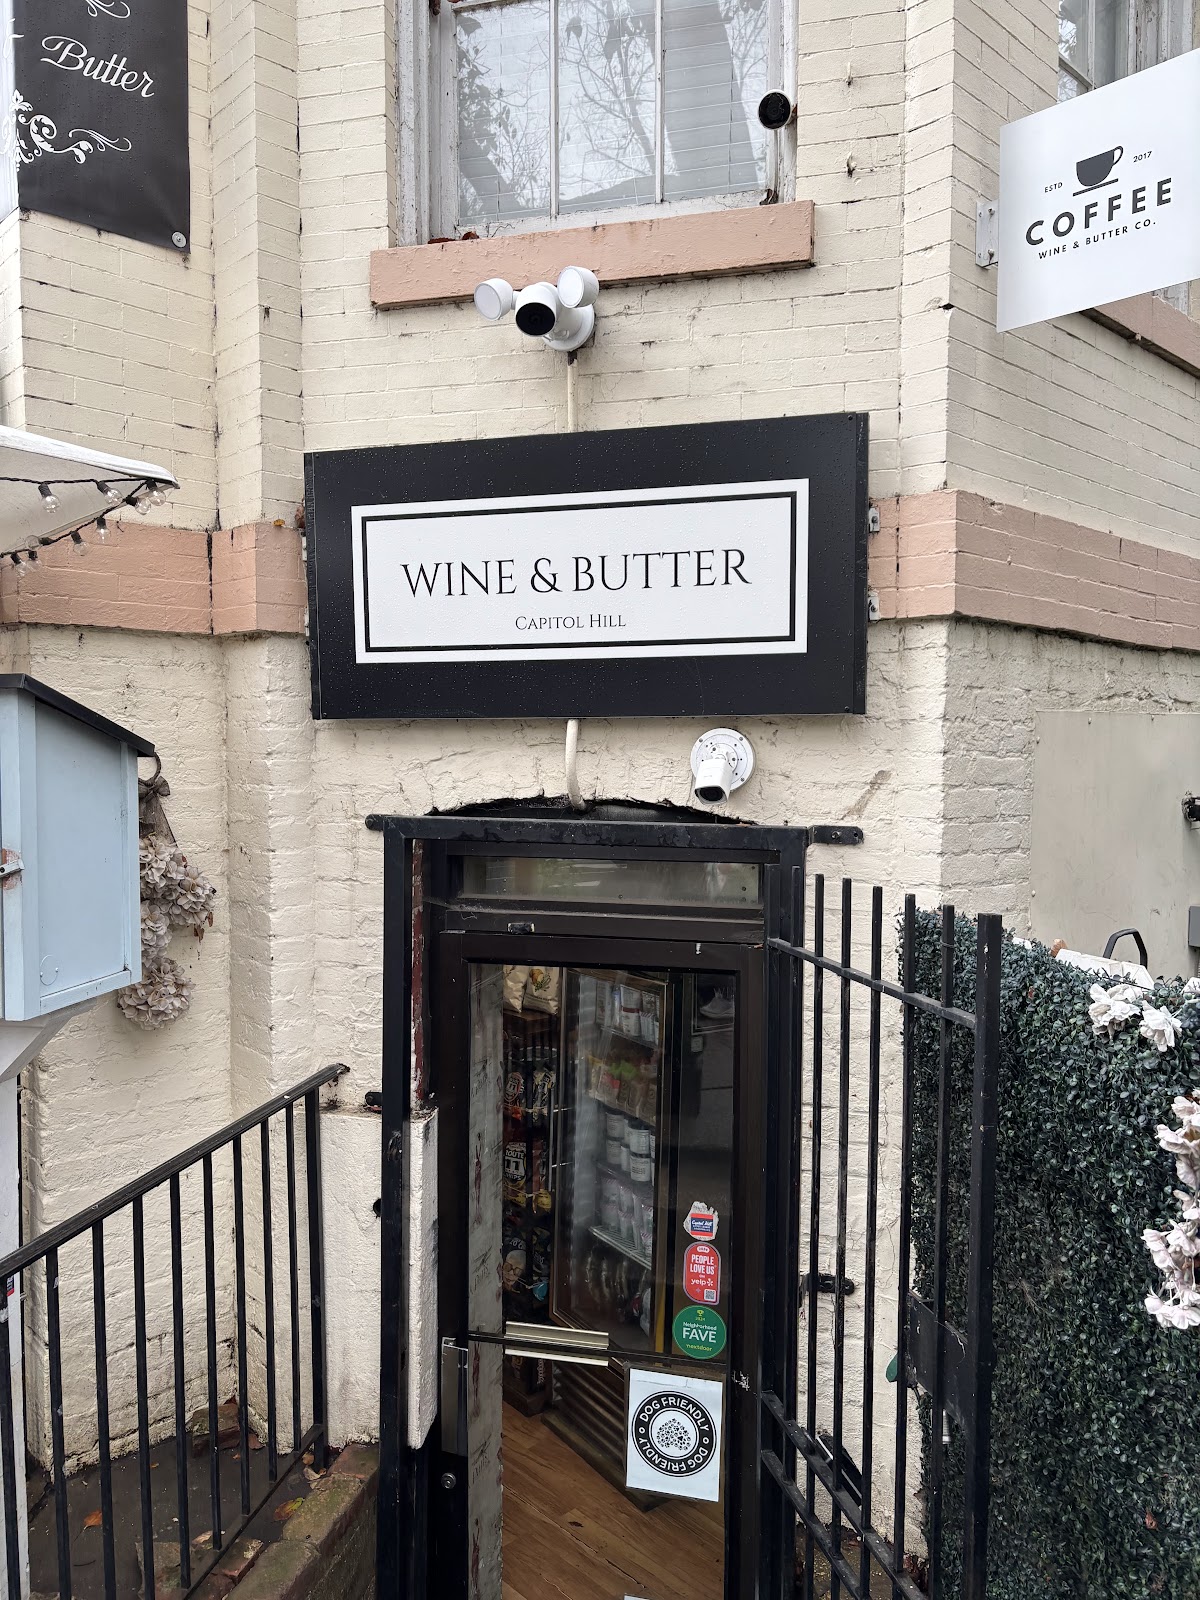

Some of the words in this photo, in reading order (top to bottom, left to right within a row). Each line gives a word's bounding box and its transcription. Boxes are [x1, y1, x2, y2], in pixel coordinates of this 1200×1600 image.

[40, 35, 154, 98] Butter
[1044, 181, 1063, 193] ESTD
[1132, 150, 1152, 163] 2017
[1025, 177, 1172, 246] COFFEE
[1038, 244, 1067, 260] WINE
[1072, 240, 1080, 249] &
[1085, 225, 1128, 246] BUTTER
[1134, 218, 1156, 230] CO.
[401, 558, 518, 598] WINE
[530, 557, 563, 594] &
[572, 548, 752, 593] BUTTER
[515, 615, 584, 630] CAPITOL
[589, 613, 627, 629] HILL
[690, 1263, 706, 1274] LOVE
[706, 1265, 715, 1275] US
[691, 1254, 715, 1266] PEOPLE
[691, 1278, 707, 1286] yelp
[682, 1327, 717, 1343] FAVE
[639, 1400, 660, 1422] DOG
[661, 1396, 710, 1432] FRIENDLY
[639, 1438, 687, 1472] FRIENDLY
[688, 1447, 708, 1468] DOG
